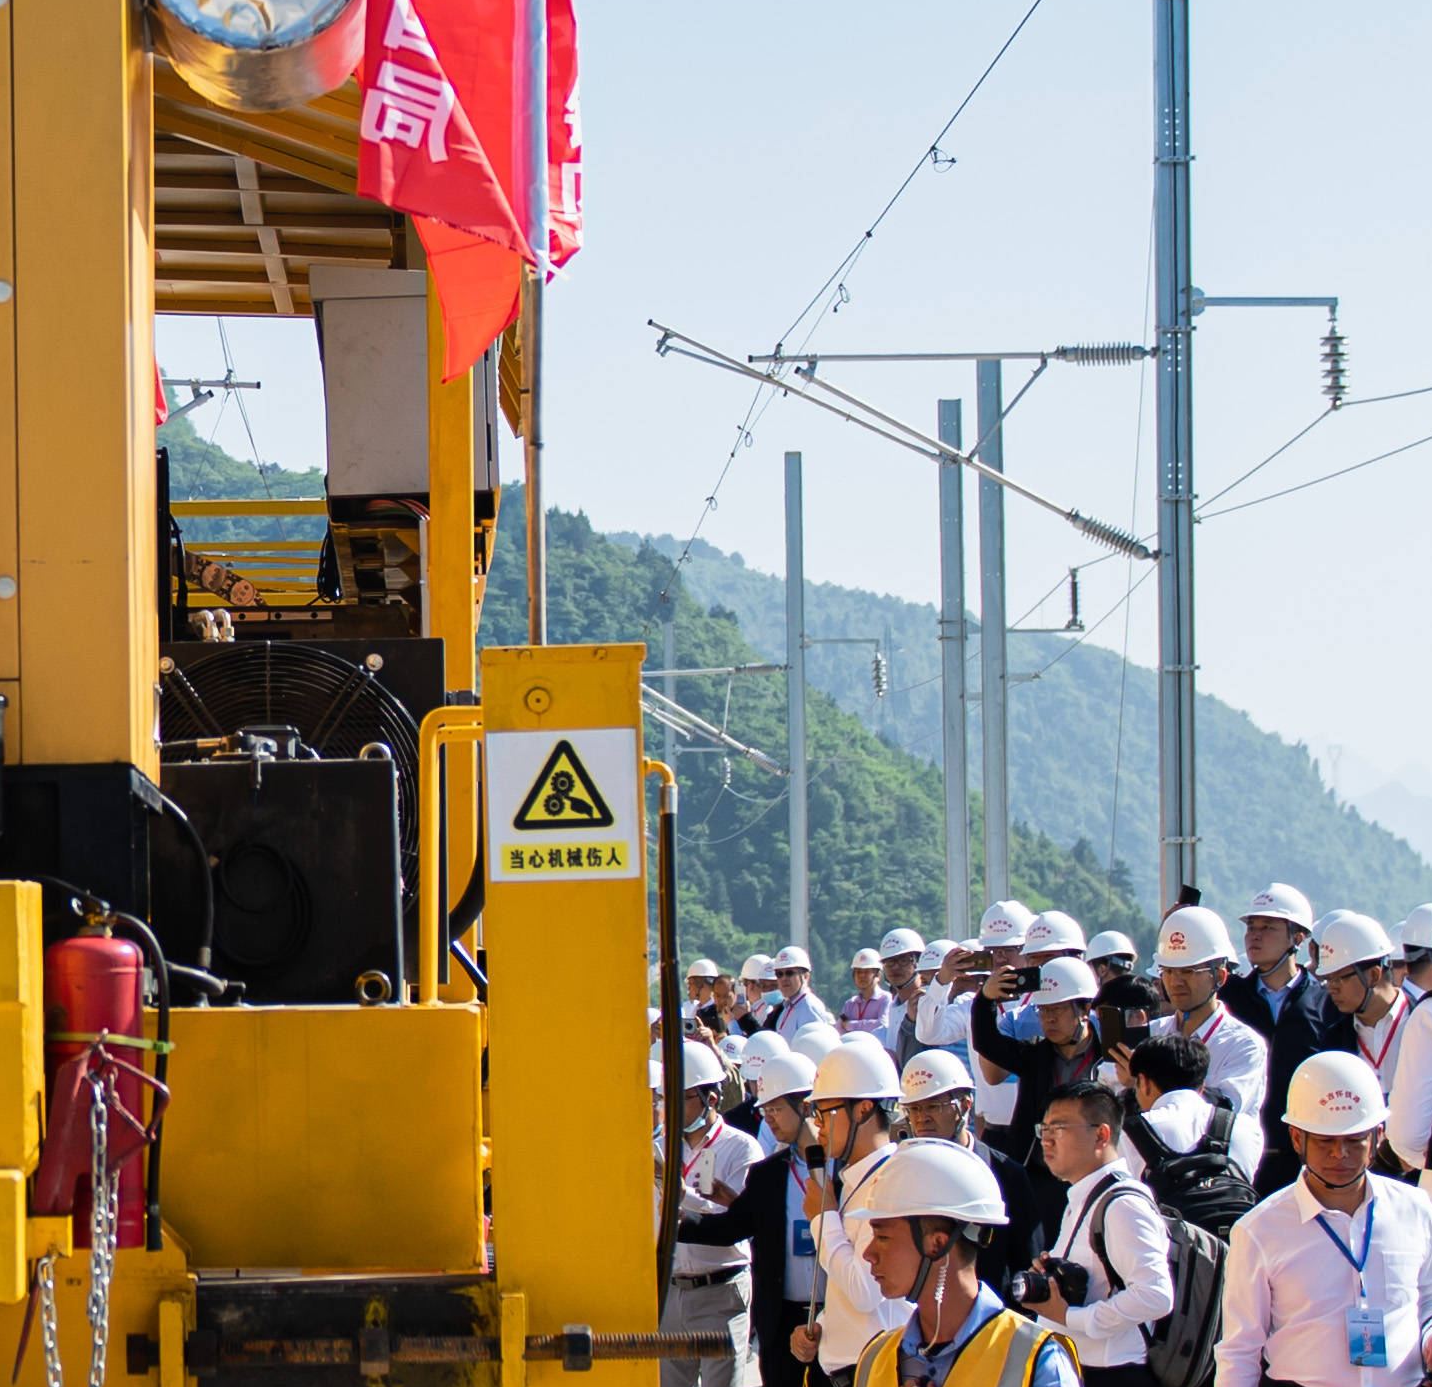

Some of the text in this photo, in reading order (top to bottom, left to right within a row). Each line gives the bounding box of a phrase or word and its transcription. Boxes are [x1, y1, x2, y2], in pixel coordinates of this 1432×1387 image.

[510, 847, 621, 869] 当心机械伤人
